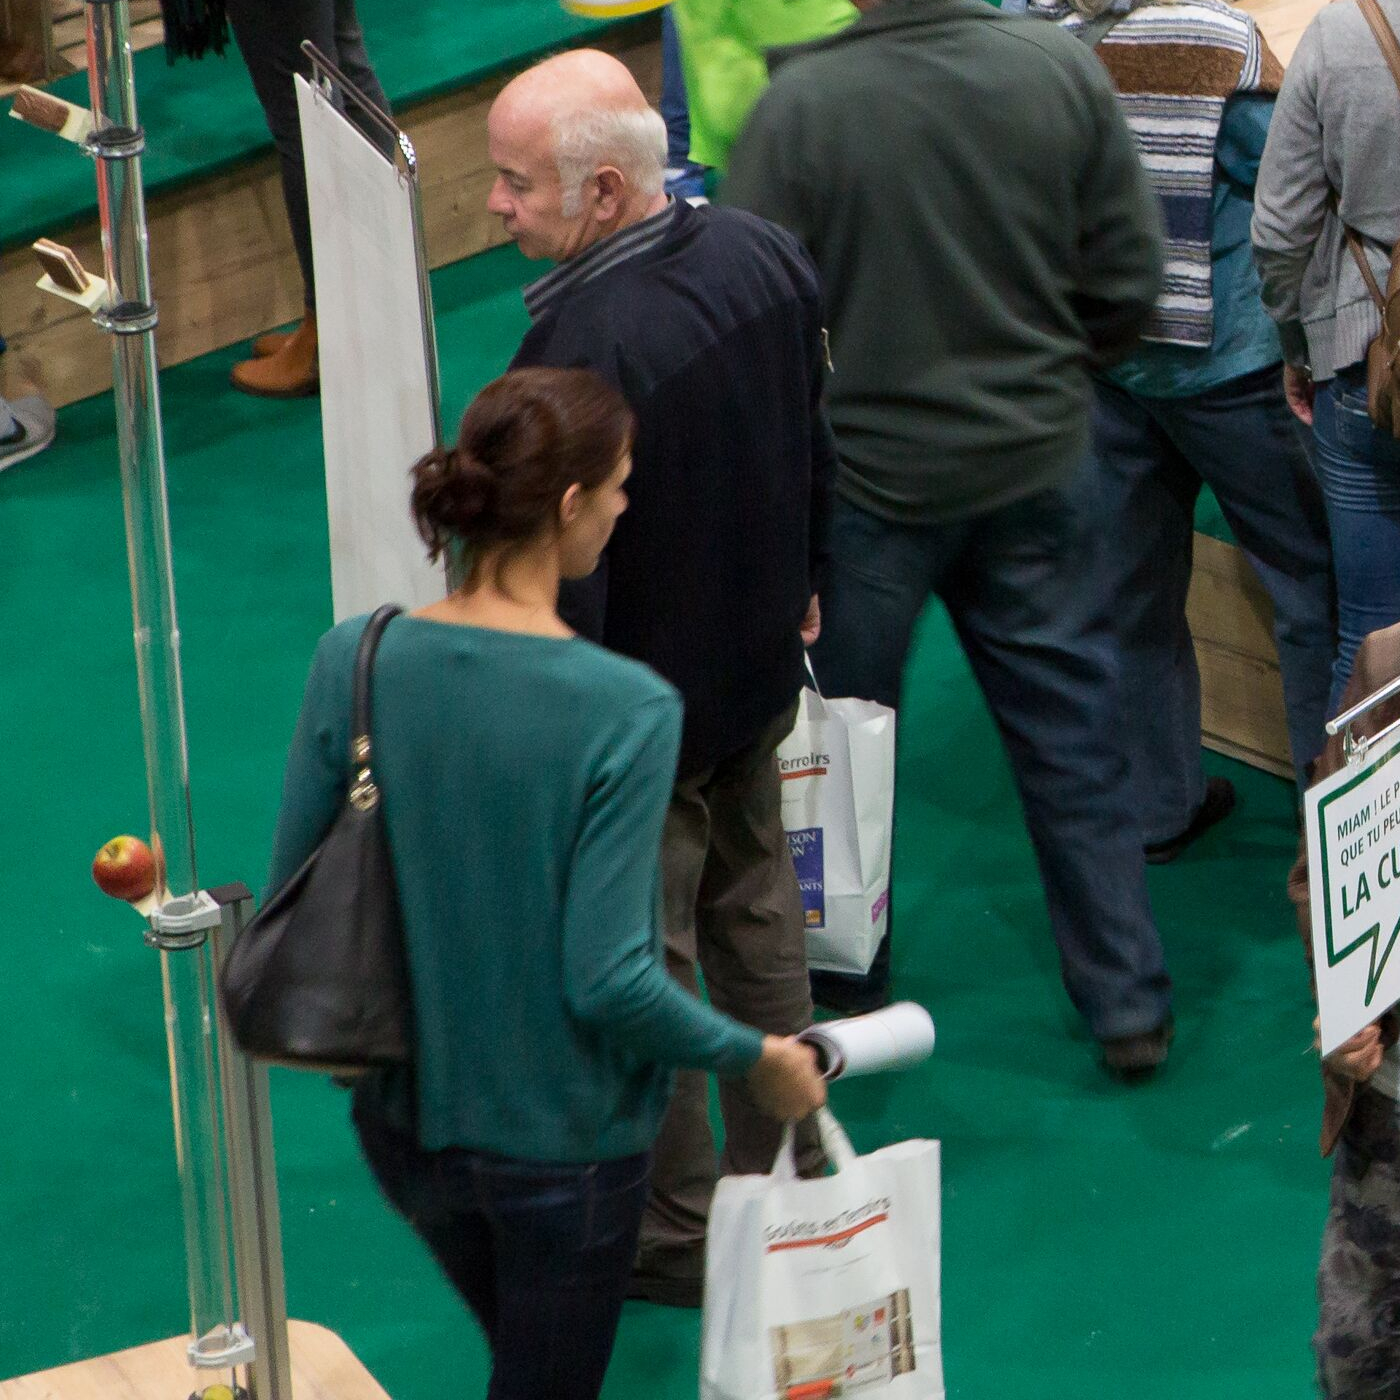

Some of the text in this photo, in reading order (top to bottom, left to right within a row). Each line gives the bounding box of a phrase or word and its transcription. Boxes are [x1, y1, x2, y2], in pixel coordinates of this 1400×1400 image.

[778, 752, 830, 770] erroirs
[1337, 805, 1371, 841] MIAM
[1380, 788, 1391, 811] LE
[1340, 837, 1364, 868] QUE
[1367, 825, 1381, 848] TU
[1340, 872, 1371, 920] LA
